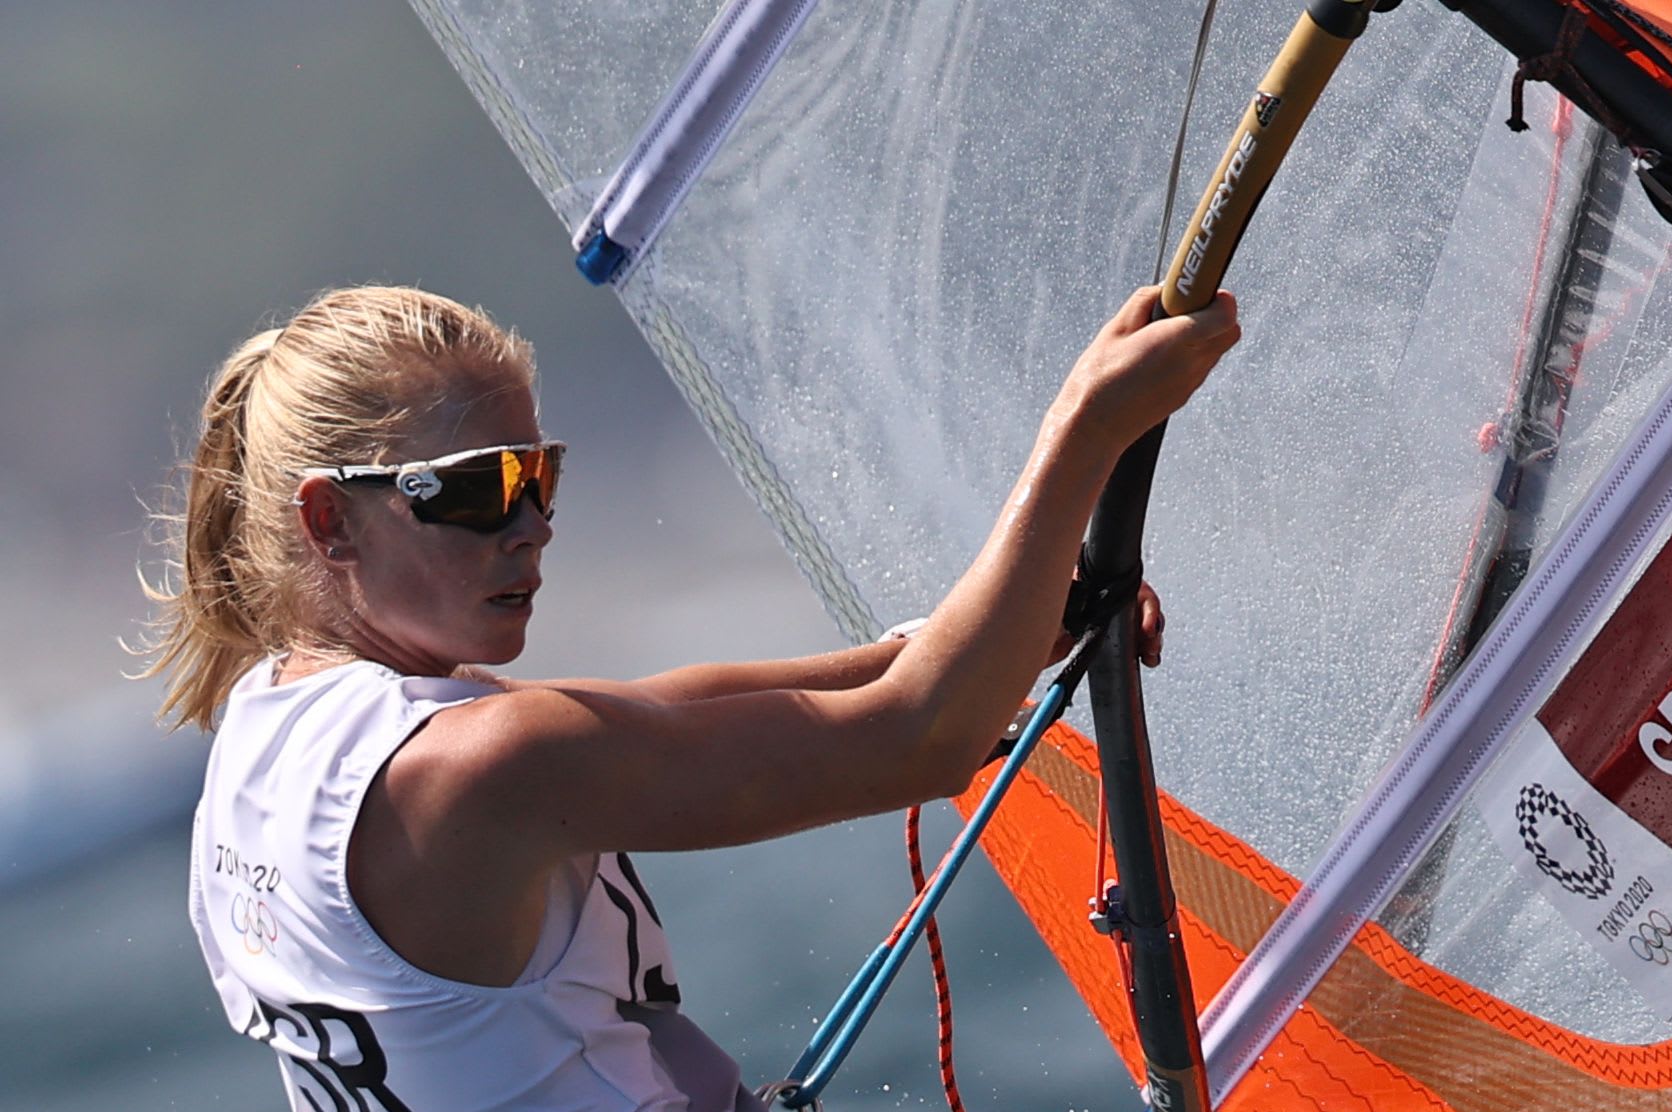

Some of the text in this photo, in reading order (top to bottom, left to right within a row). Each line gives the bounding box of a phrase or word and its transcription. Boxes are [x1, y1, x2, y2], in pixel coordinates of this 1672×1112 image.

[1177, 132, 1257, 296] NEILPRYDE
[1597, 875, 1654, 943] TOKYO 2020
